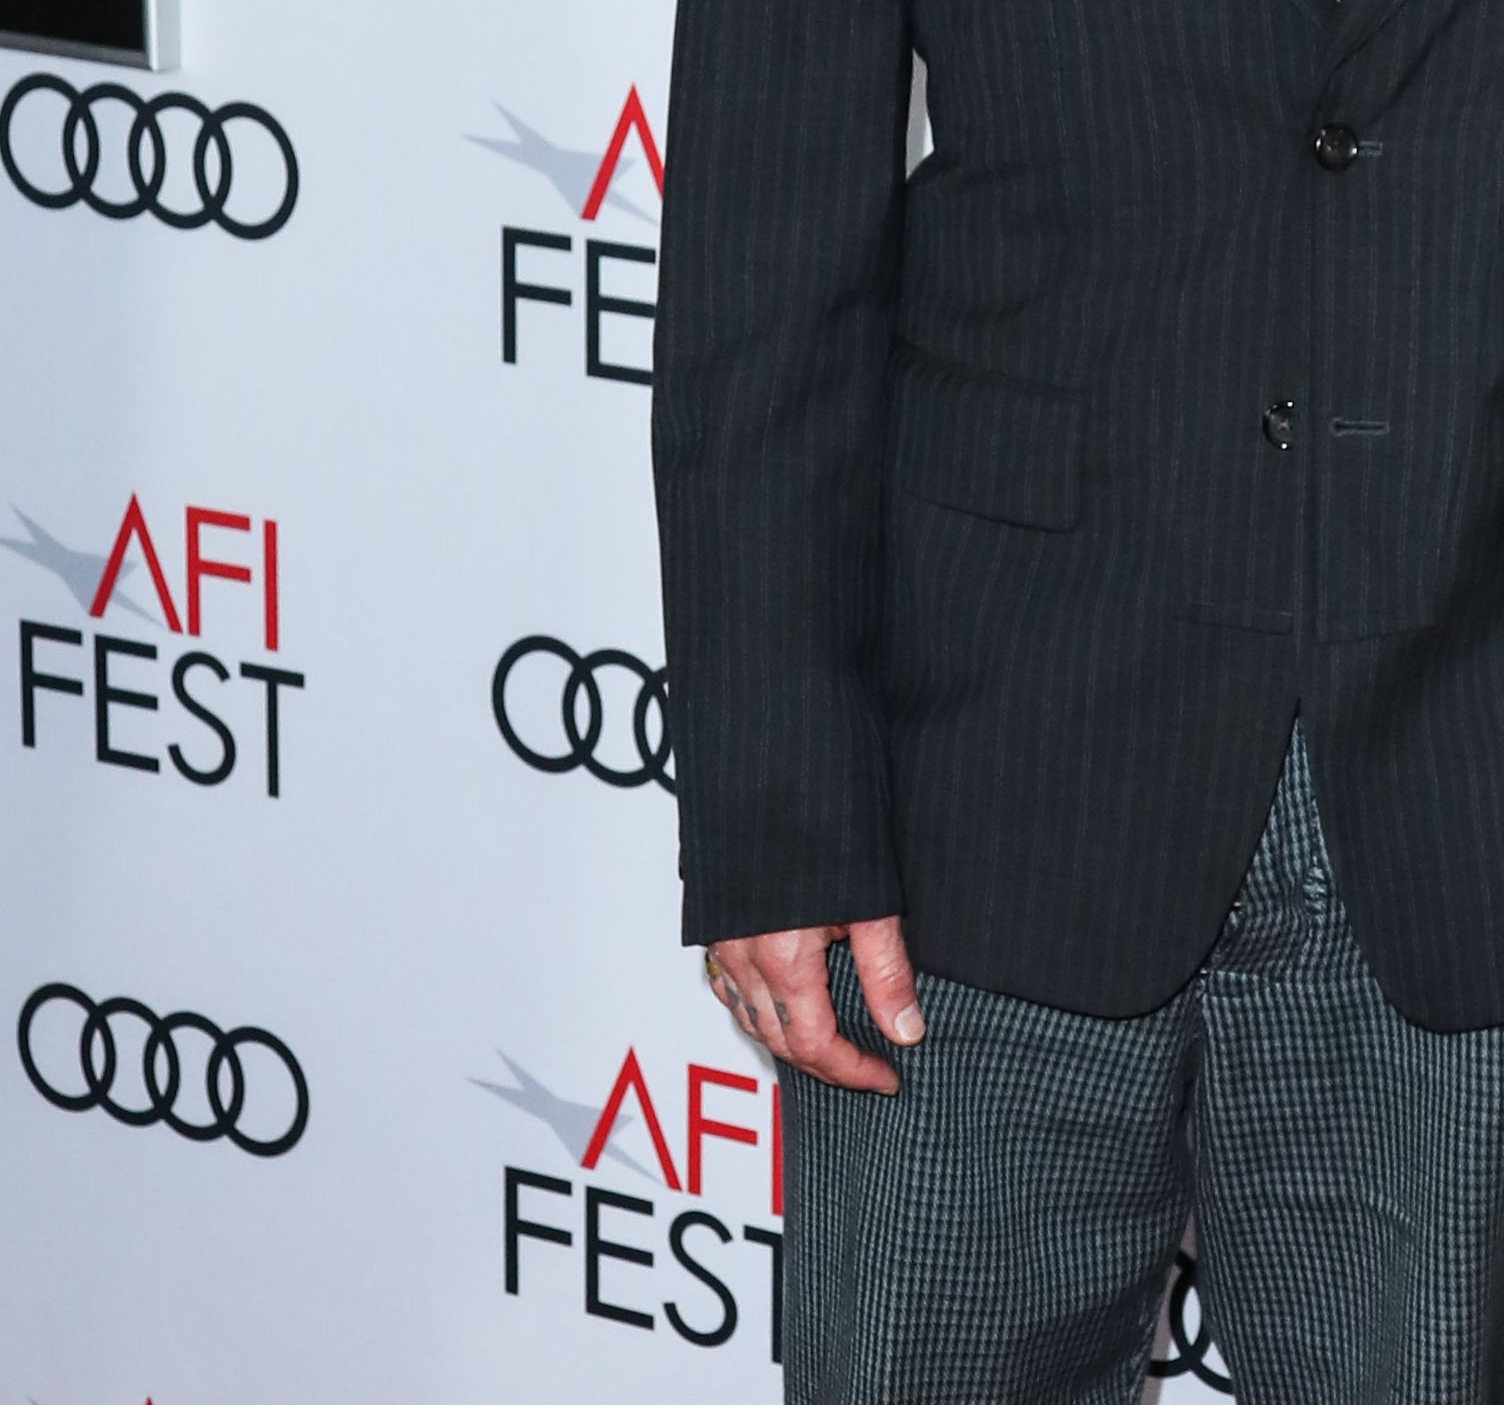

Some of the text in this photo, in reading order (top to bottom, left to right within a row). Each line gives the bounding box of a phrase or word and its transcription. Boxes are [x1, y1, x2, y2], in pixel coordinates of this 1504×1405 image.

[502, 226, 657, 386] FE
[90, 492, 279, 651] AFI
[20, 619, 305, 798] FEST
[580, 1045, 783, 1216] AFI
